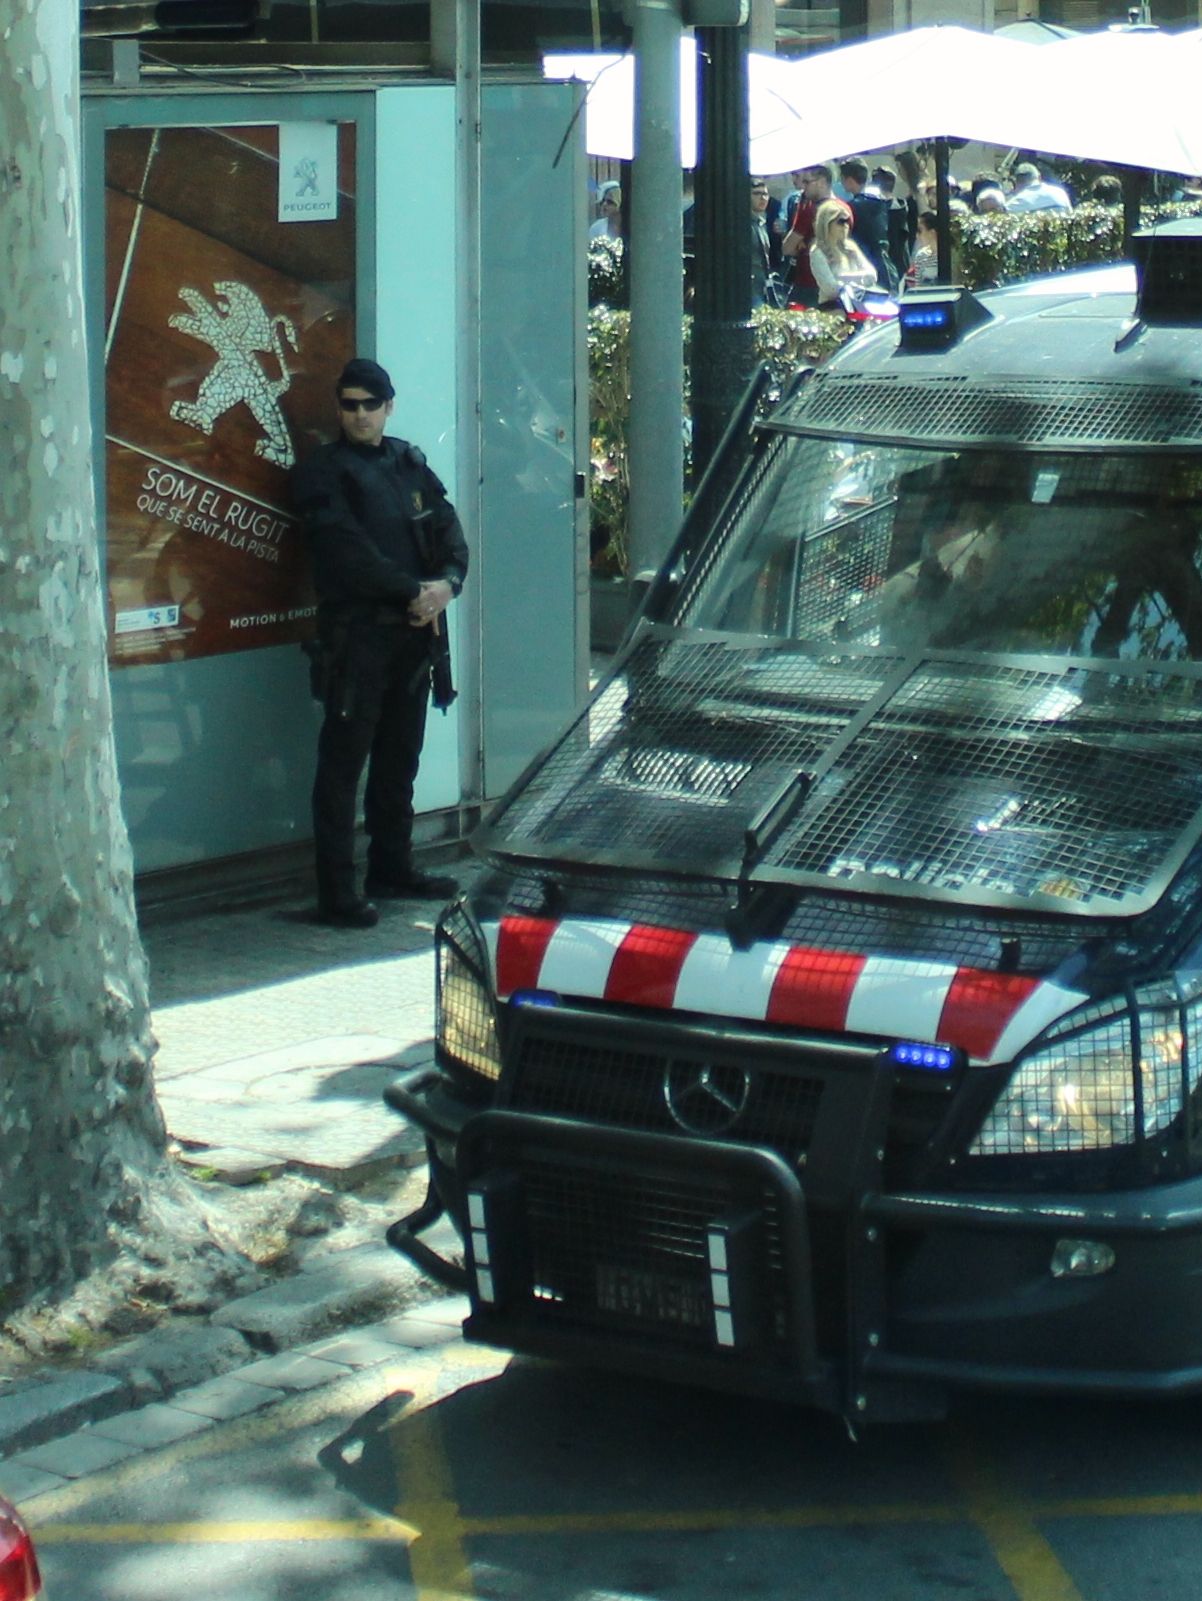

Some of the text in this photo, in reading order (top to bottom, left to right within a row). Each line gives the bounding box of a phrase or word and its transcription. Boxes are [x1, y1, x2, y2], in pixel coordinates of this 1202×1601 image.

[283, 202, 331, 212] PEUGEOT
[136, 494, 279, 564] QUE SE SENT A LA PISTA
[142, 468, 289, 544] SOM EL RUGIT
[229, 612, 277, 629] MOTION
[287, 606, 318, 620] EMOT
